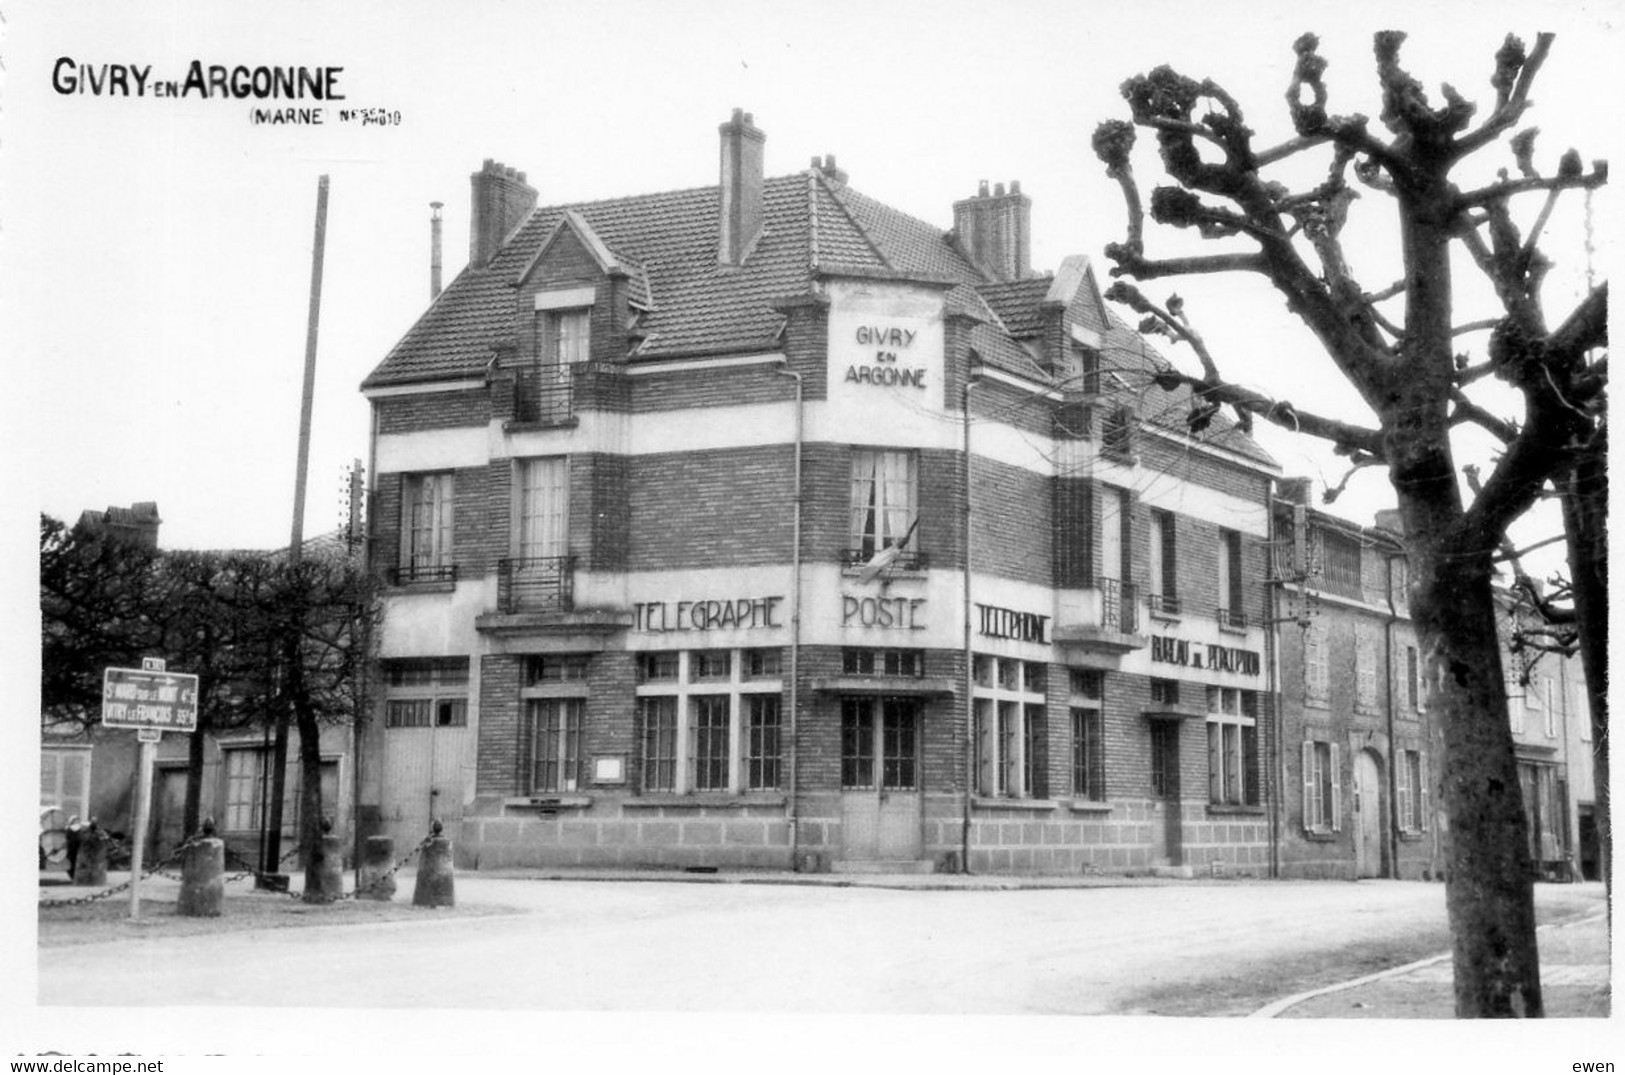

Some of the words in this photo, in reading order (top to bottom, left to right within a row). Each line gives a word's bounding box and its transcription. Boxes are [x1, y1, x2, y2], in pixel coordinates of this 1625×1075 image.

[856, 326, 917, 347] GIVRY
[876, 351, 897, 362] EN
[844, 364, 928, 390] ARGONNE
[842, 595, 927, 630] POSTE
[1151, 634, 1190, 666] BUREAU
[1205, 643, 1261, 677] PERCEPTION
